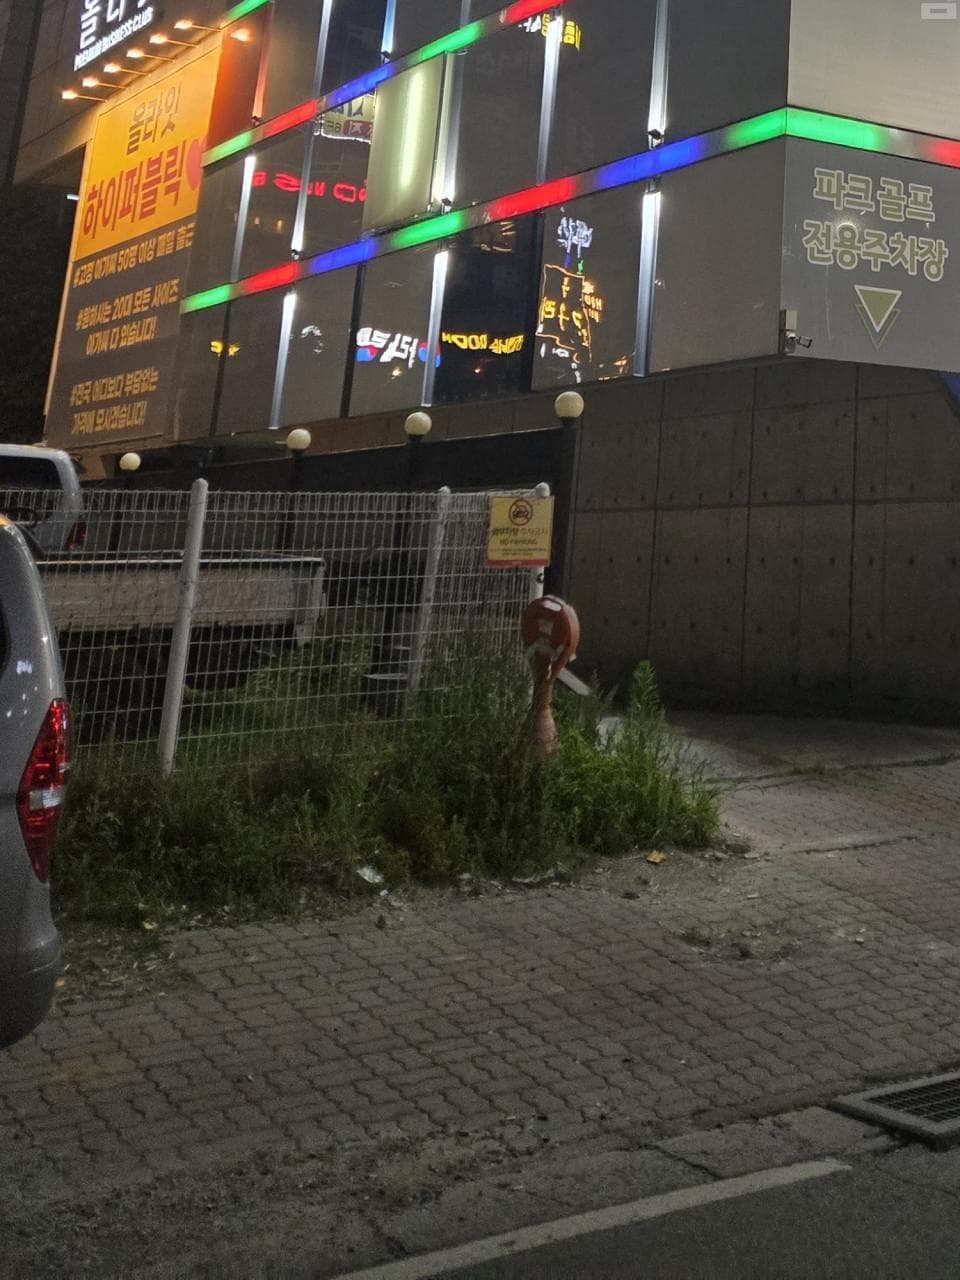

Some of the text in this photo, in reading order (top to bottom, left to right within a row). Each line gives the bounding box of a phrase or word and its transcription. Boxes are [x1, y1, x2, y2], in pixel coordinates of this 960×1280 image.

[127, 82, 181, 156] 올라잇
[83, 139, 187, 239] 하이퍼블릭
[802, 219, 948, 282] 전용주차장
